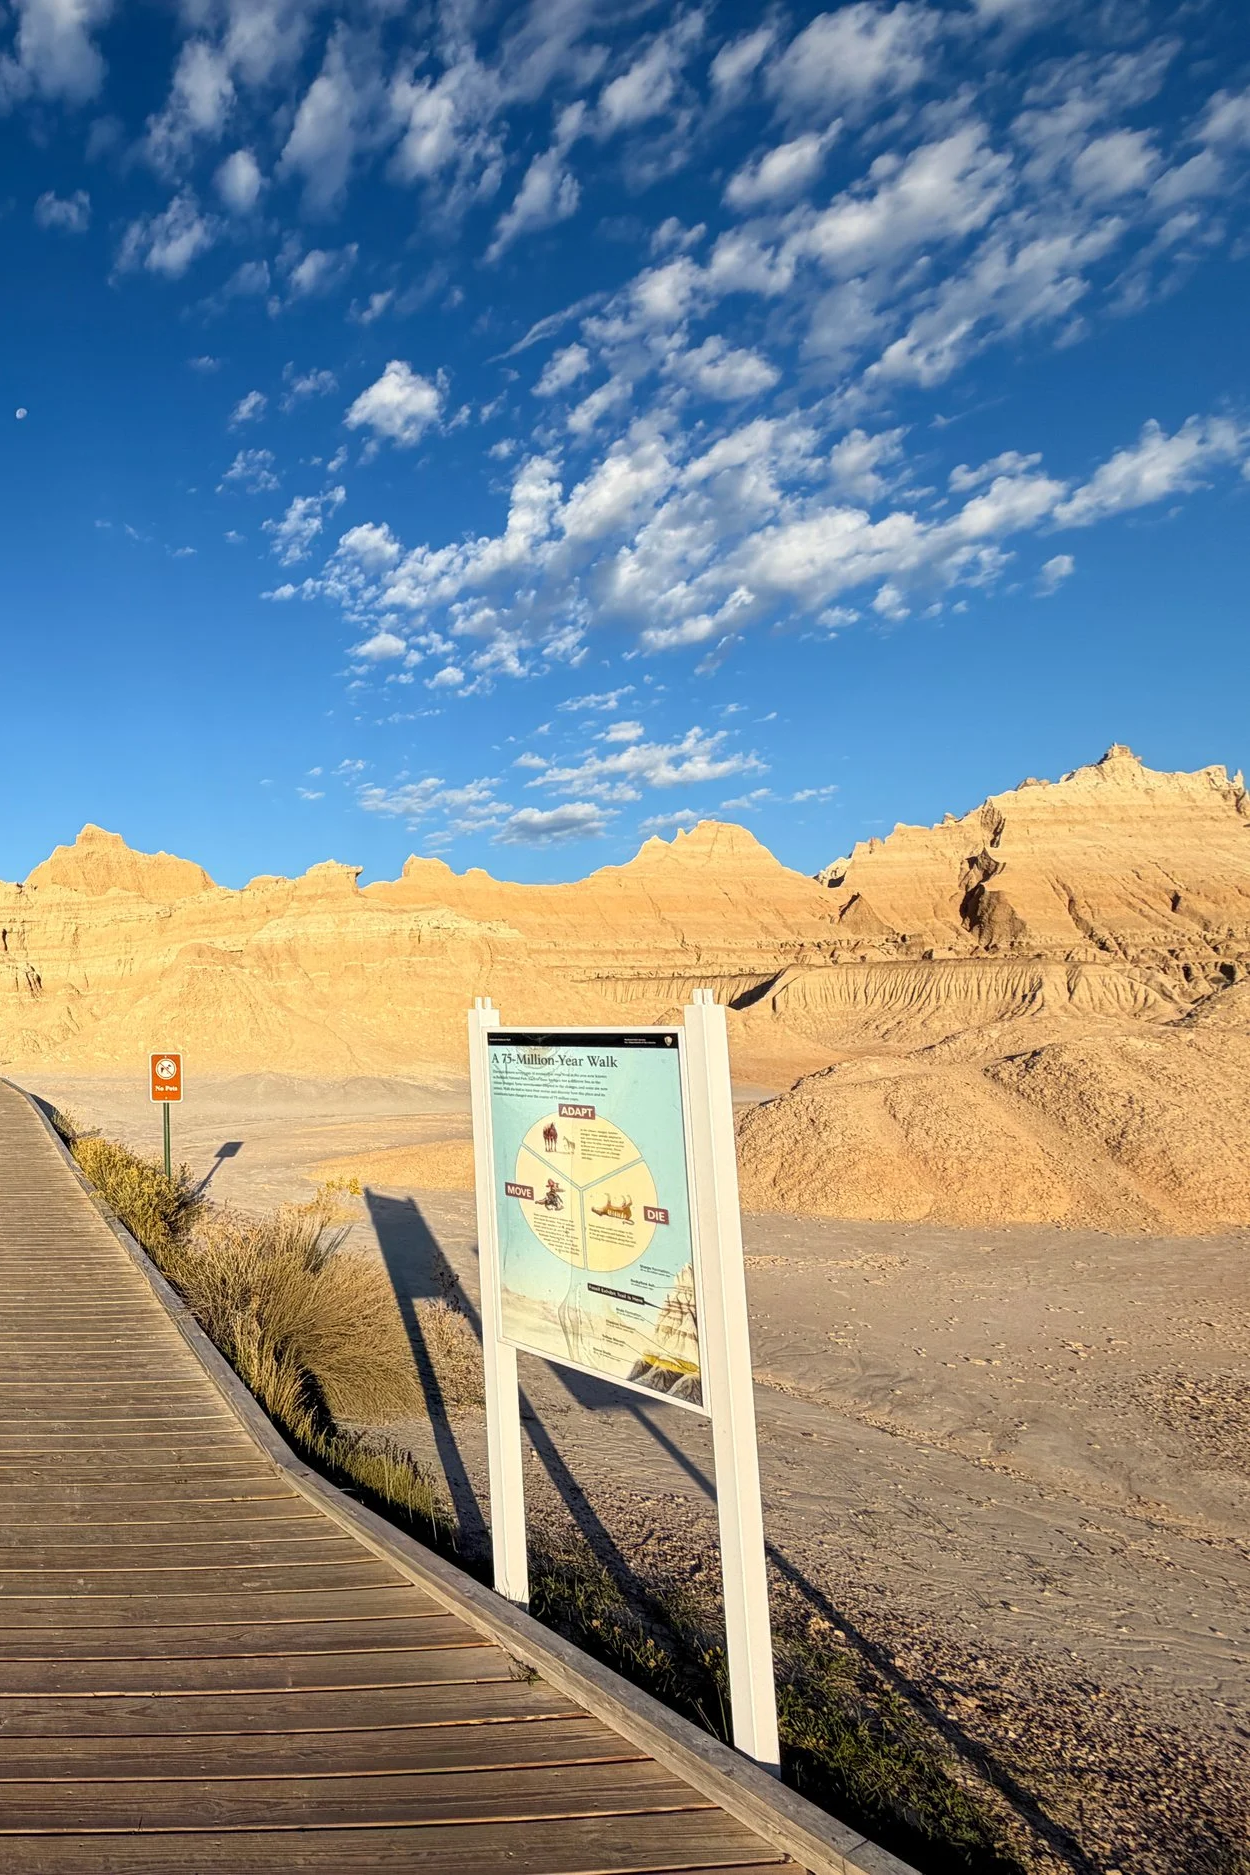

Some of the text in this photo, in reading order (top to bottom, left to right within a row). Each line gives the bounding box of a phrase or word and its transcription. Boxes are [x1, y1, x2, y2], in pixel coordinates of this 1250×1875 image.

[491, 1053, 618, 1068] A 75-Million-Year Walk
[561, 1106, 593, 1118] ADAPT
[507, 1185, 532, 1198] MOVE
[646, 1209, 665, 1222] DIE
